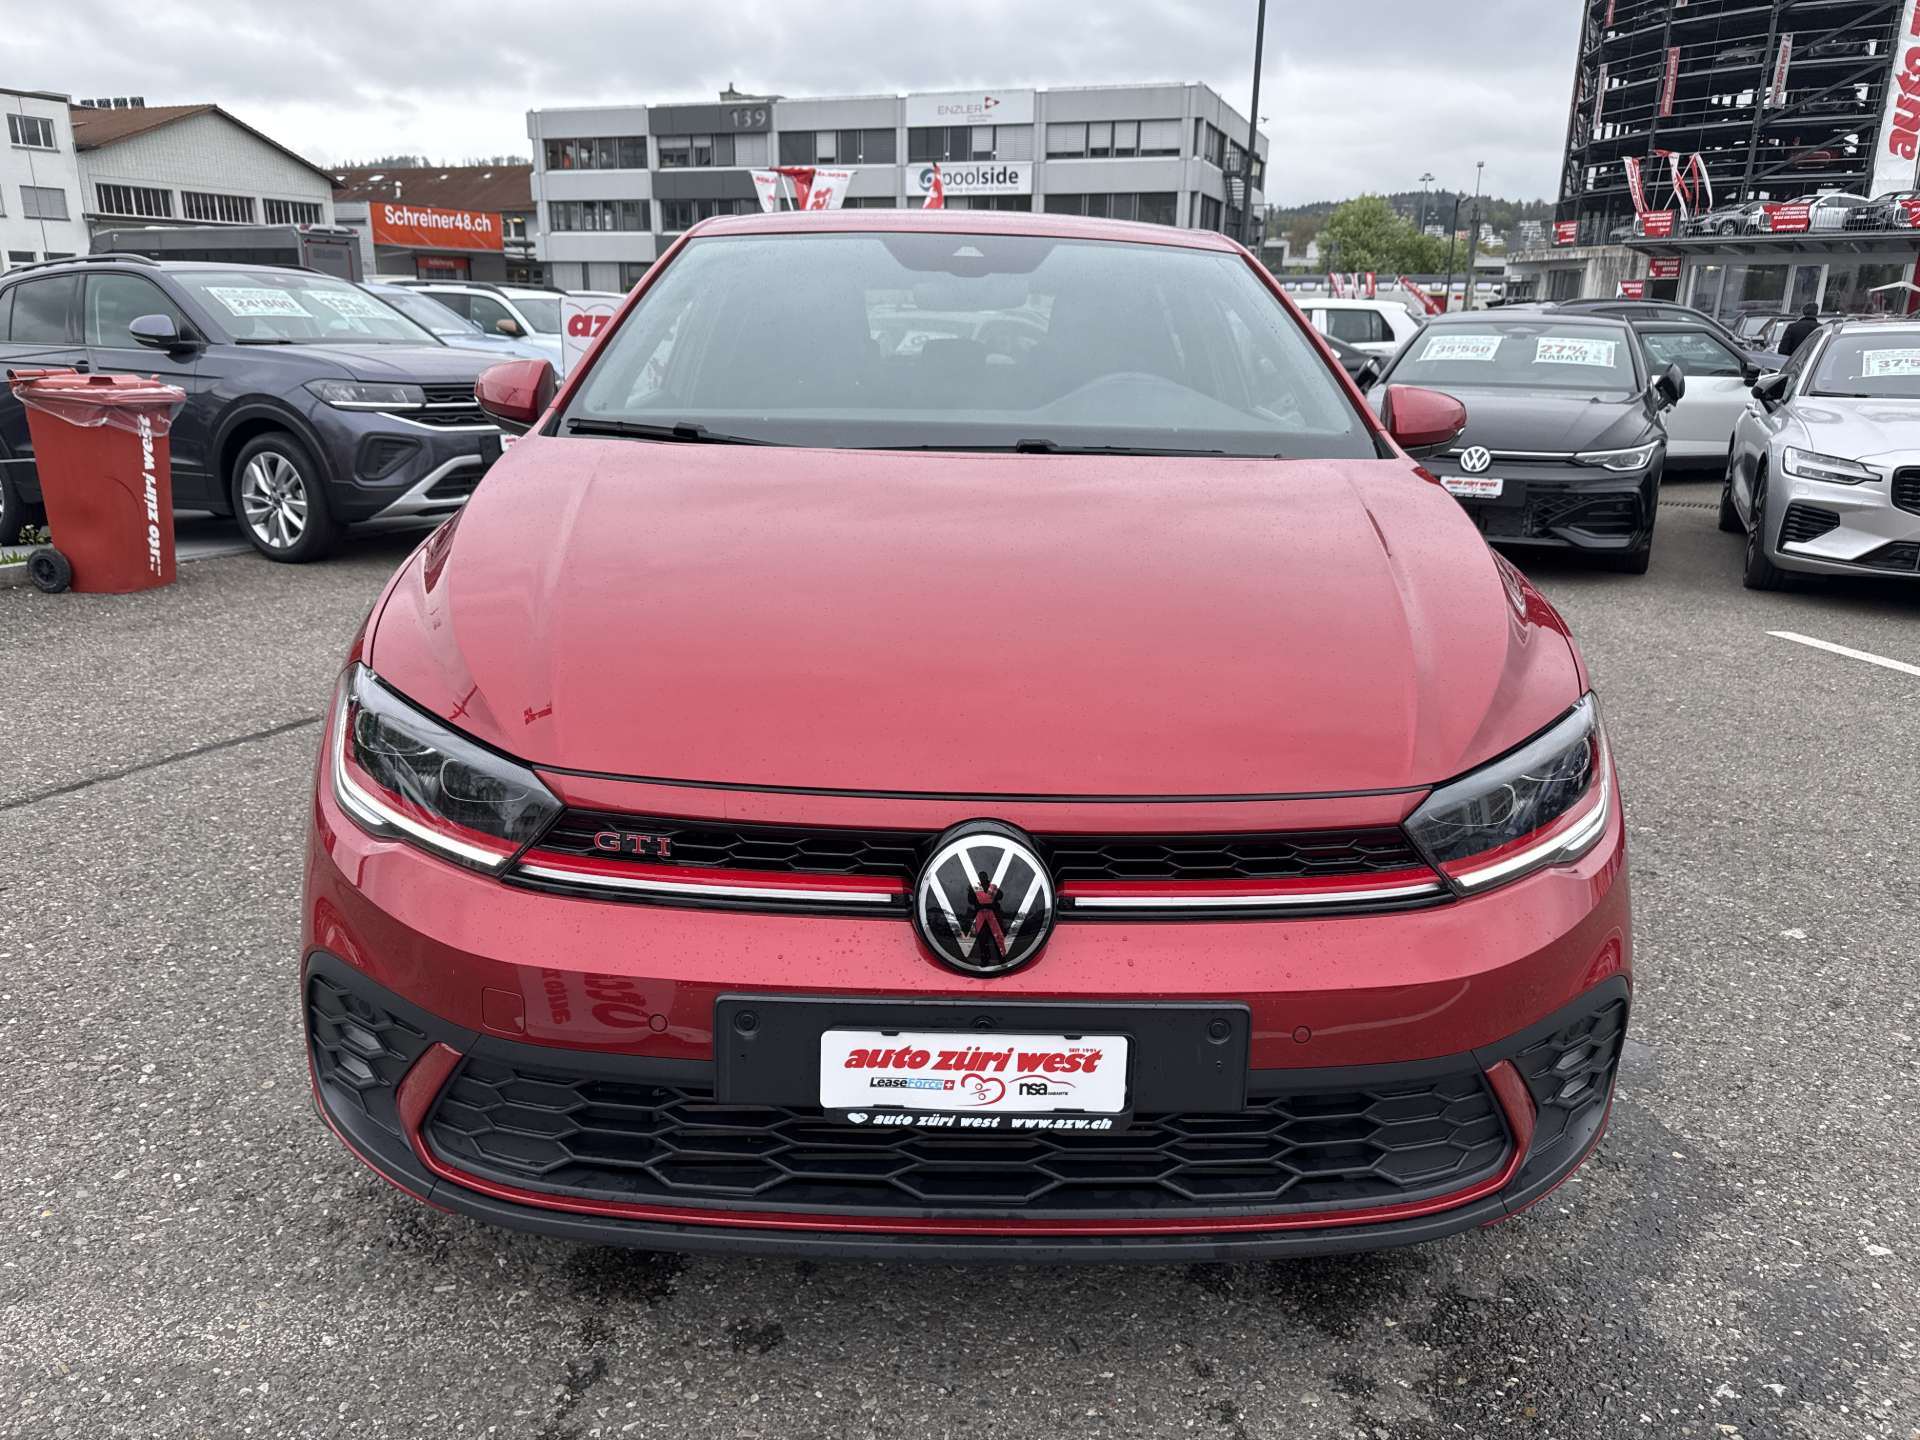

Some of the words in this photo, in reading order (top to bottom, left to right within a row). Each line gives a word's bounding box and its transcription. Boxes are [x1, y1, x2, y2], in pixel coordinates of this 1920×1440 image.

[937, 103, 983, 116] ENZLER
[732, 110, 767, 128] 139
[943, 166, 1019, 186] poolside
[384, 204, 492, 232] Schreiner48.ch
[1540, 344, 1588, 355] 27%
[594, 831, 672, 857] GTI
[844, 1045, 932, 1070] auto
[931, 1046, 1014, 1073] züri
[1017, 1049, 1104, 1073] west
[869, 1077, 944, 1090] LeaseForce
[1019, 1082, 1048, 1096] nsa
[872, 1114, 914, 1126] auto
[915, 1114, 956, 1127] züri
[960, 1116, 1001, 1128] west
[1011, 1118, 1113, 1130] www.azw.ch
